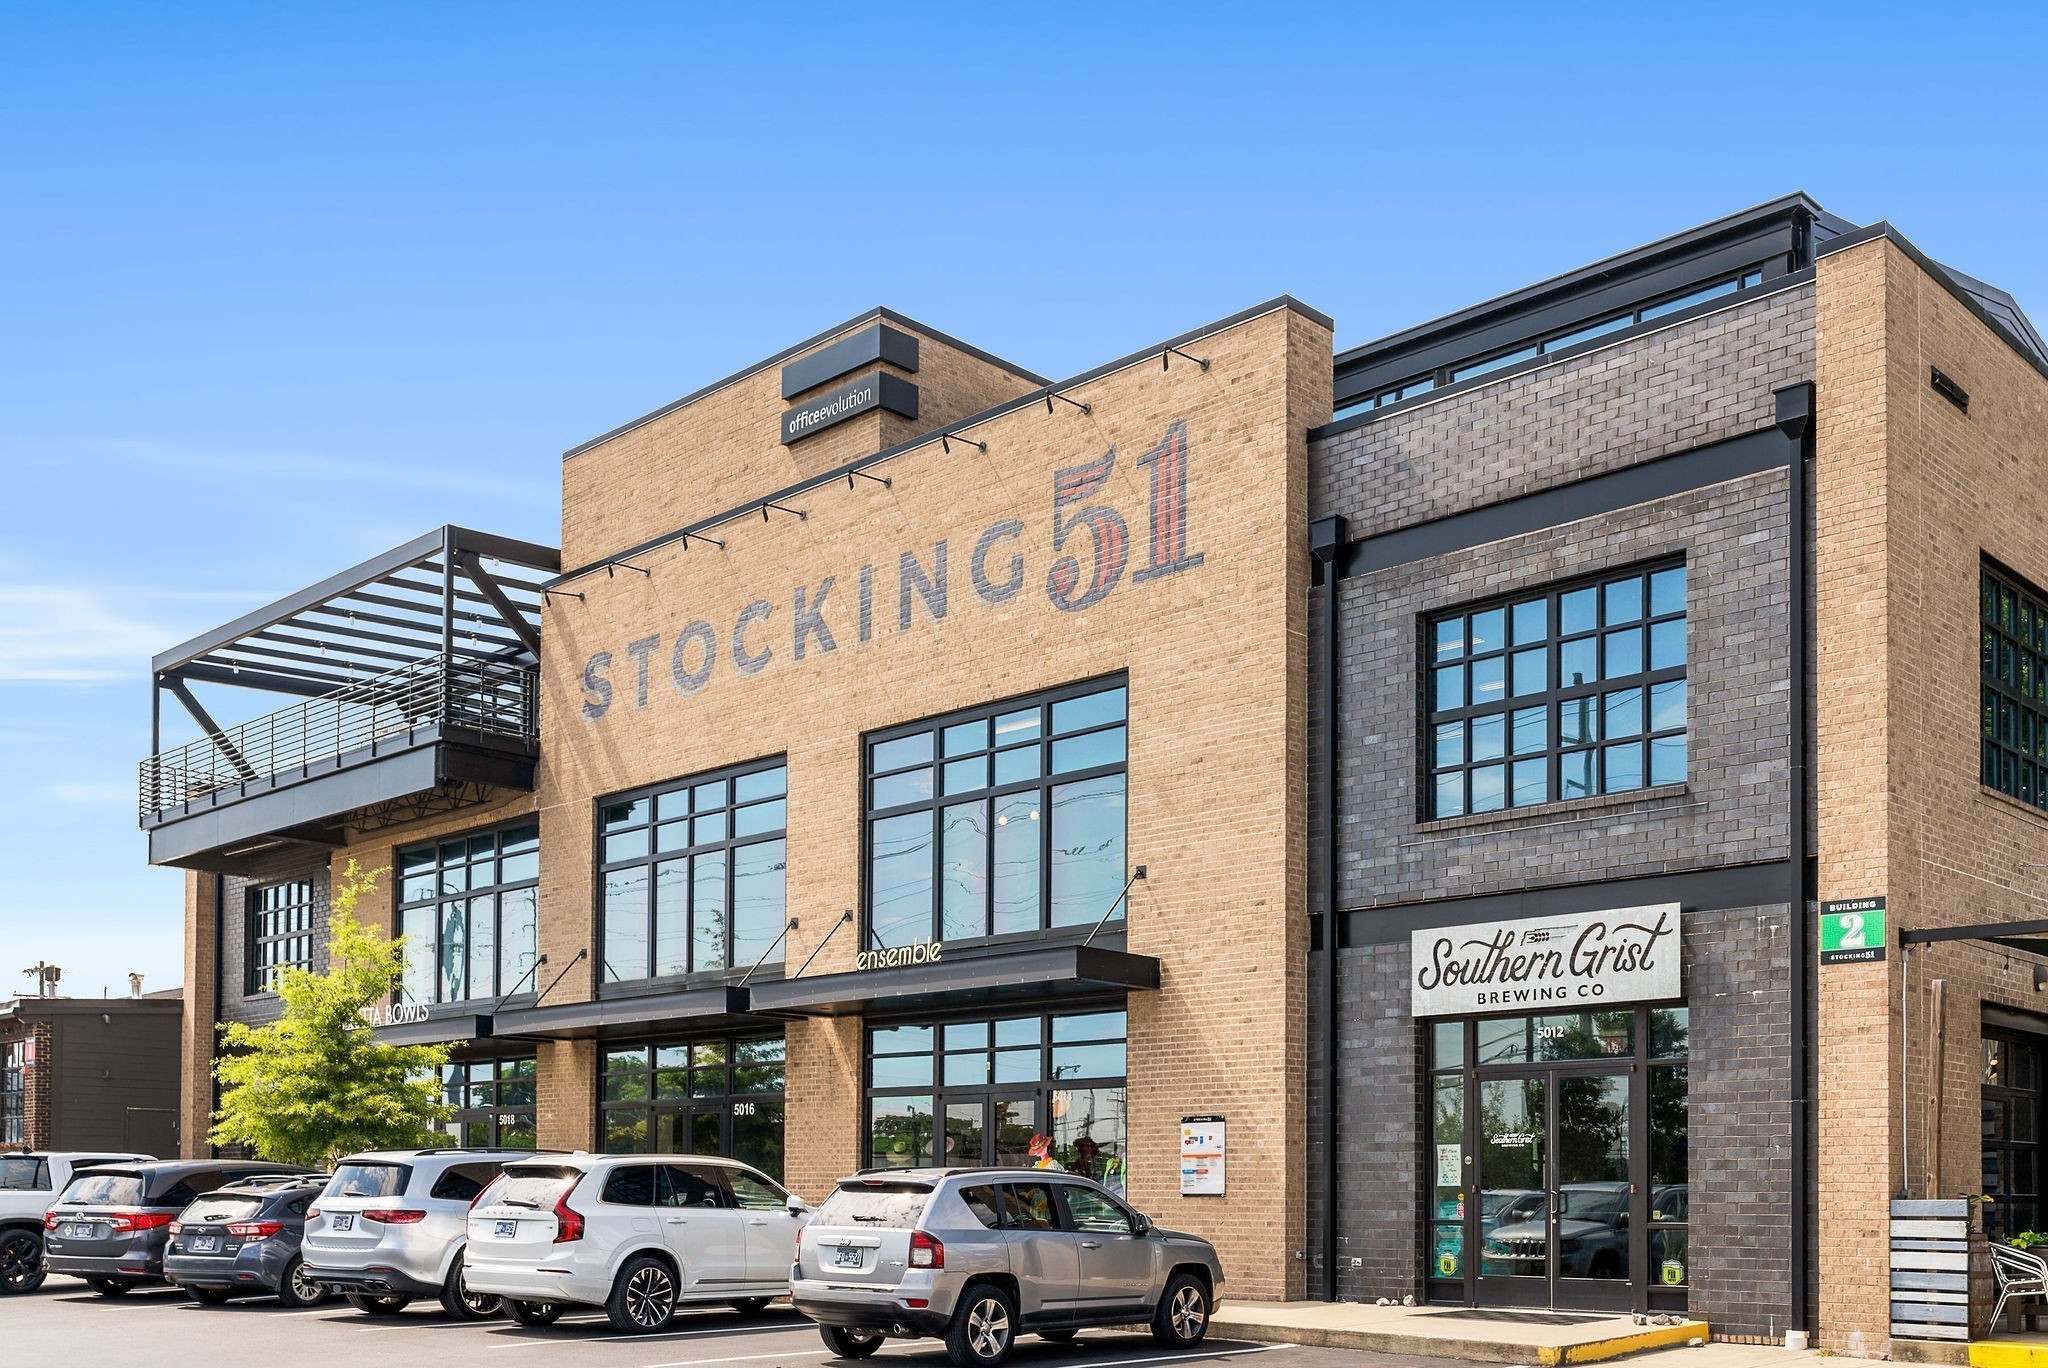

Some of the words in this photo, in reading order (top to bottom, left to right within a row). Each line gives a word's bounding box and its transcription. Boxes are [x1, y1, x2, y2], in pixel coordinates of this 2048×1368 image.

[789, 387, 871, 433] officeevolution
[581, 519, 1025, 724] STOCKING
[1046, 420, 1205, 612] 51
[1829, 901, 1876, 911] BUILDING
[1840, 913, 1865, 948] 2
[856, 936, 942, 970] ensemble
[1418, 929, 1564, 990] Southern
[1570, 912, 1673, 979] Grist
[1478, 986, 1567, 1005] BREWING
[1578, 983, 1604, 997] CO
[386, 1001, 429, 1025] BOWLS
[1536, 1026, 1564, 1039] 5012
[499, 1114, 515, 1125] 5018
[734, 1103, 755, 1116] 5016
